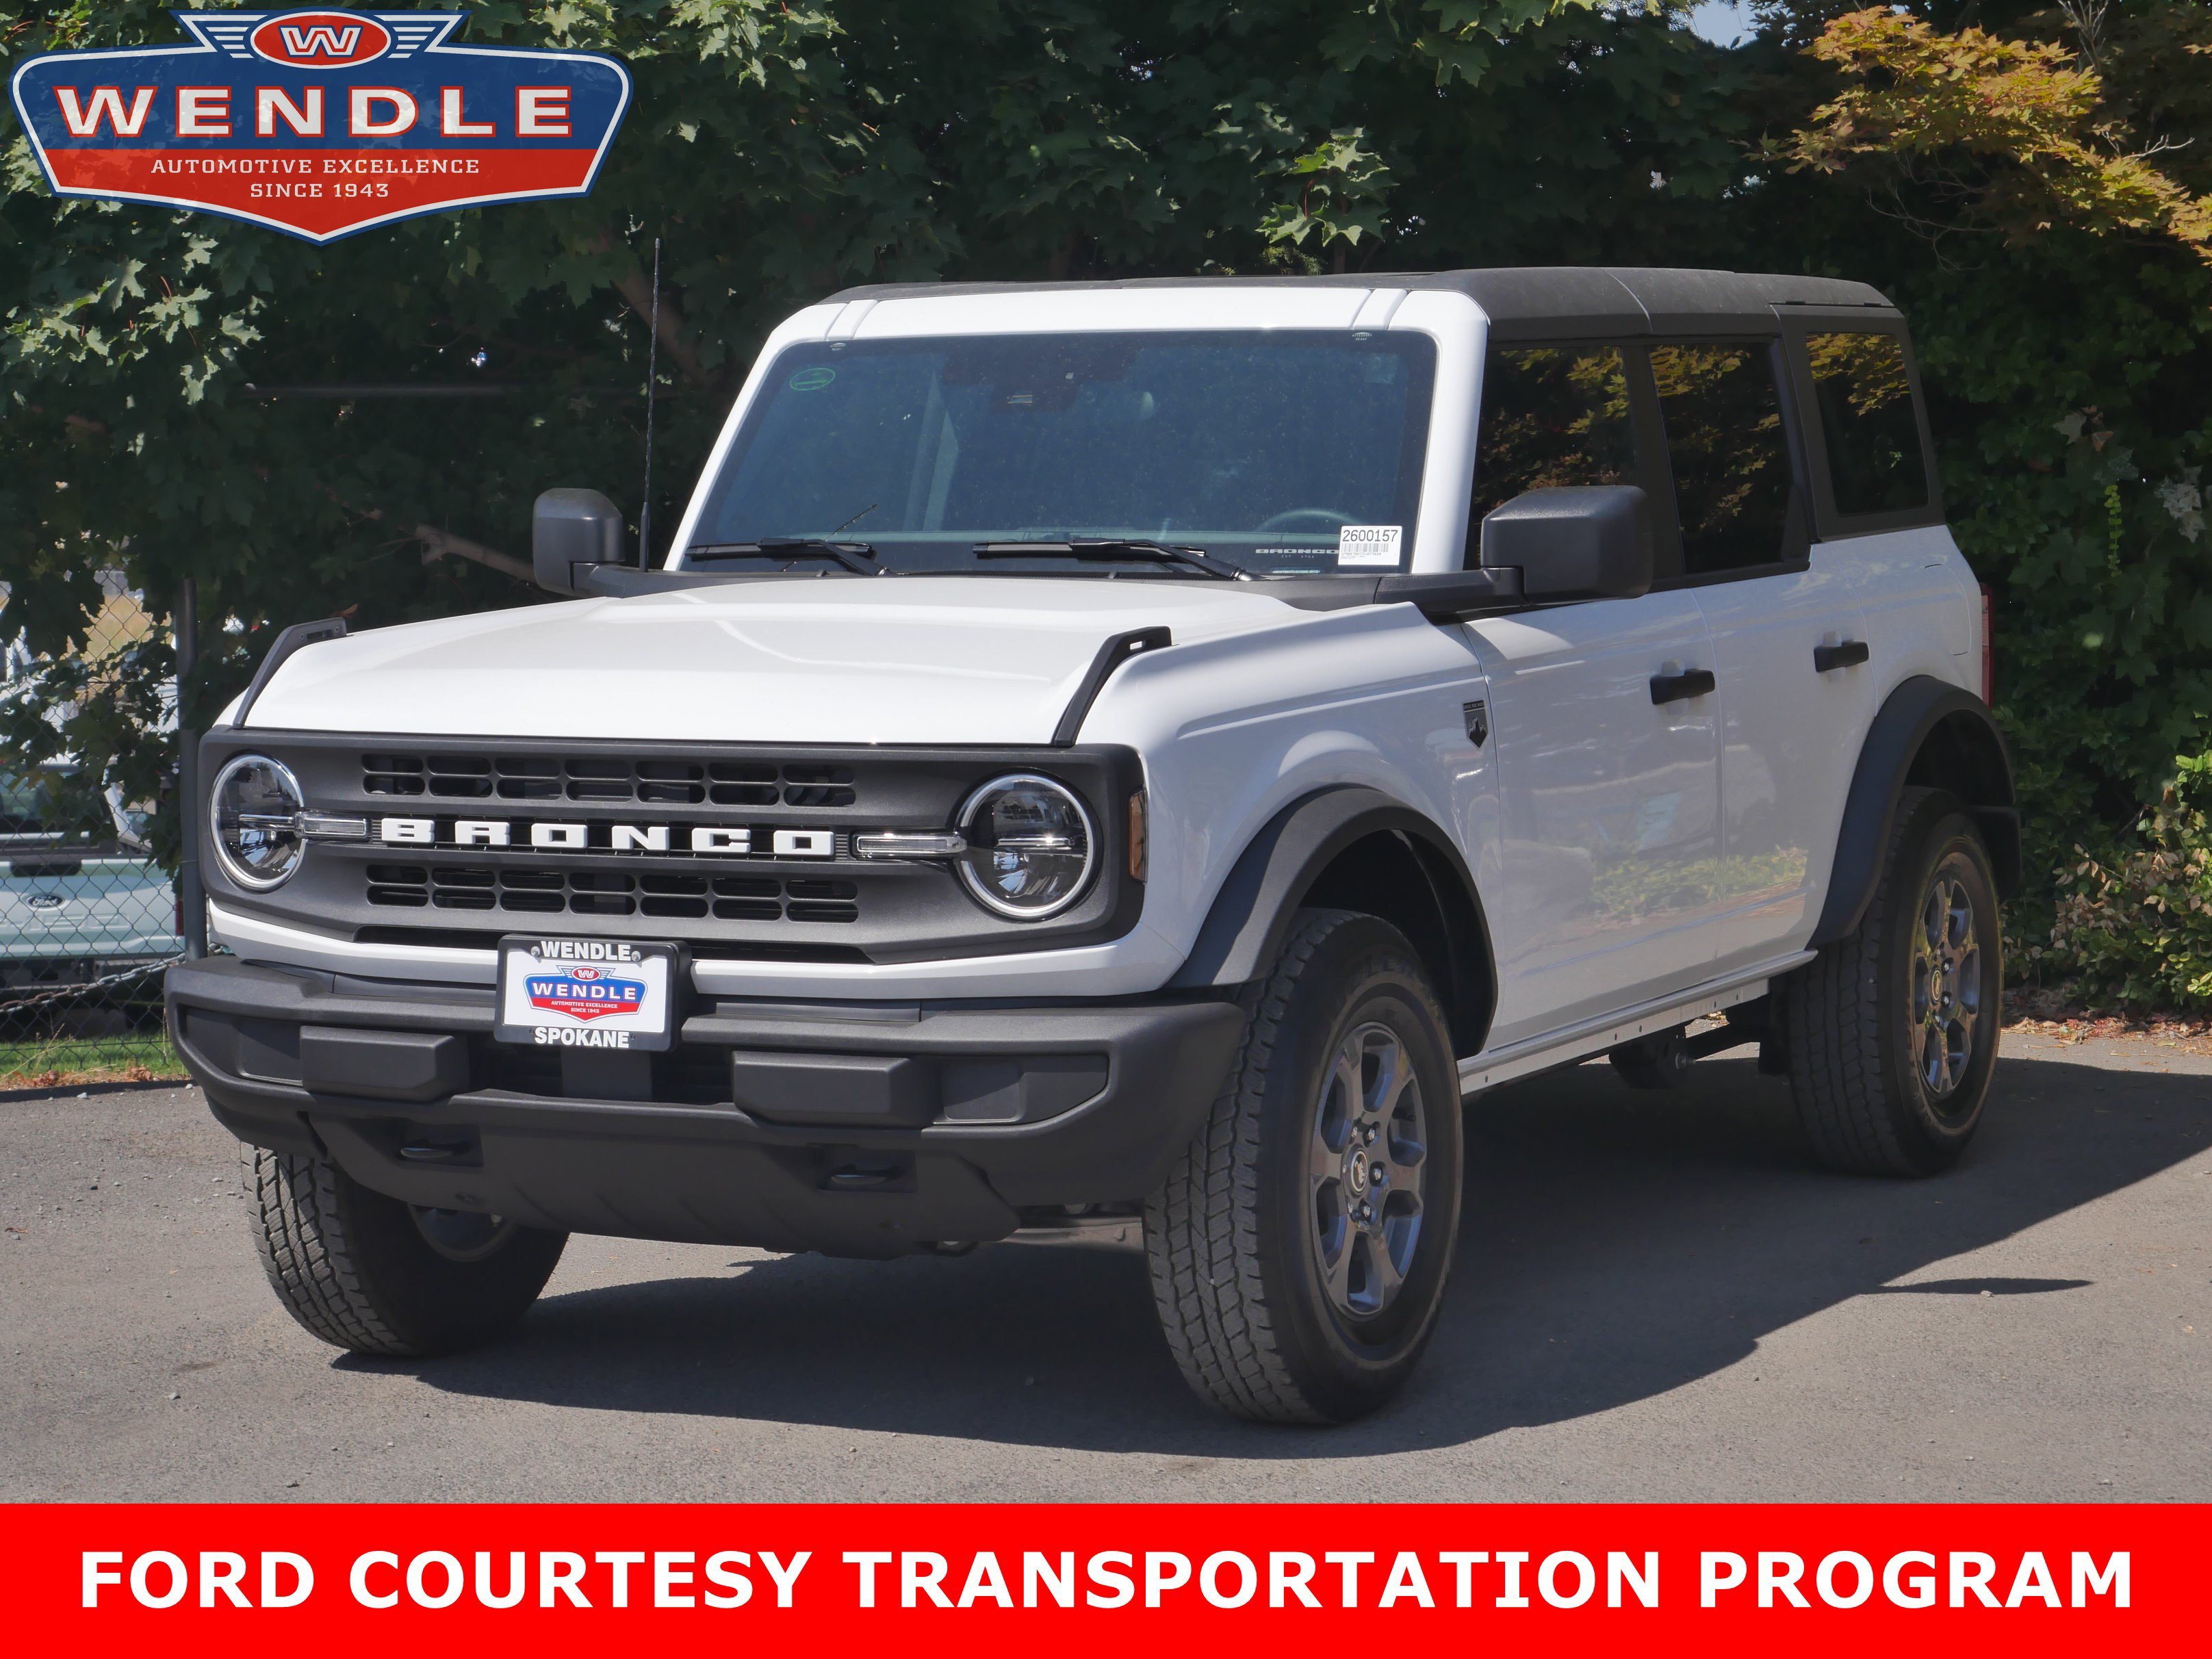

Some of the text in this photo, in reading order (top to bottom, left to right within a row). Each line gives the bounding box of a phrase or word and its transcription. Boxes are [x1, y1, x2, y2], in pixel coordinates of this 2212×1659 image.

[1342, 529, 1398, 542] 2600157
[381, 817, 835, 856] BRONCO
[541, 940, 631, 961] WENDLE
[532, 982, 636, 1000] WENDLE
[535, 1027, 629, 1048] SPOKANE
